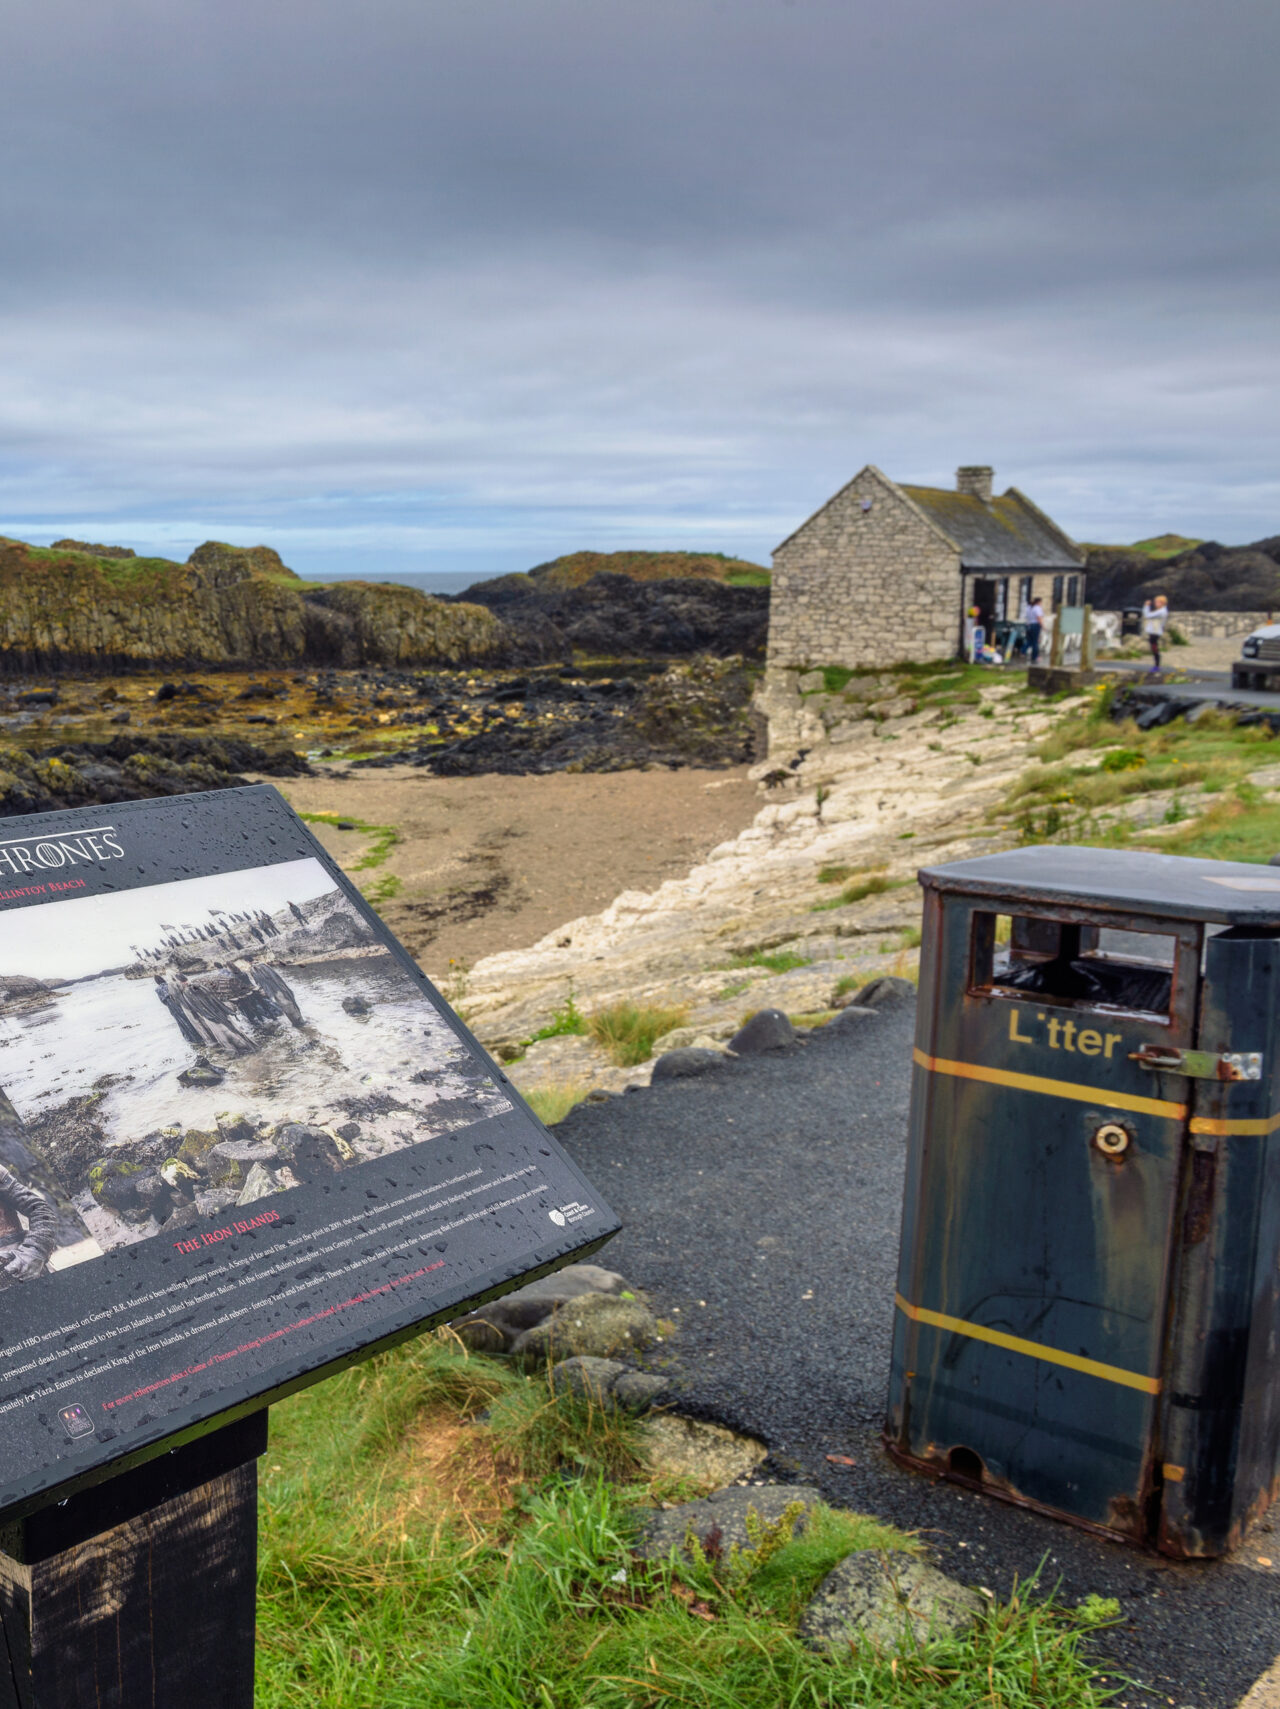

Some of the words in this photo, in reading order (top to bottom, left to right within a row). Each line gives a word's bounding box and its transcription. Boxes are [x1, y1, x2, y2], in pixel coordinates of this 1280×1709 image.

[48, 879, 86, 893] BEACH
[1008, 1009, 1123, 1058] Ltter
[22, 1334, 41, 1347] HBO
[39, 1327, 61, 1340] series
[59, 1319, 80, 1333] based
[87, 1307, 115, 1324] George
[112, 1302, 127, 1313] R.R.
[126, 1292, 154, 1307] Martin's
[151, 1279, 188, 1299] best-selling
[184, 1271, 209, 1287] fantasy
[226, 1261, 234, 1269] A
[232, 1256, 250, 1268] Song
[247, 1253, 256, 1261] of
[253, 1249, 265, 1259] Ice
[262, 1246, 275, 1255] and
[273, 1241, 288, 1251] Fire.
[286, 1235, 304, 1246] Since
[301, 1232, 312, 1240] the
[310, 1227, 326, 1238] pilot
[341, 1217, 352, 1225] the
[350, 1211, 366, 1222] show
[363, 1208, 375, 1216] has
[372, 1202, 391, 1213] filmed
[389, 1198, 405, 1207] across
[403, 1190, 422, 1201] various
[420, 1182, 442, 1195] locations
[445, 1173, 467, 1185] Northern
[173, 1239, 200, 1255] THE
[200, 1226, 234, 1246] IRON
[233, 1209, 280, 1234] ISLANDS
[1, 1359, 39, 1381] presumed
[36, 1351, 58, 1366] dead,
[55, 1346, 70, 1357] has
[68, 1335, 98, 1352] returned
[97, 1332, 107, 1341] to
[104, 1328, 118, 1338] the
[115, 1322, 131, 1334] Iron
[129, 1314, 154, 1328] Islands
[152, 1309, 166, 1319] and
[166, 1302, 185, 1314] killed
[184, 1298, 195, 1307] his
[193, 1288, 219, 1304] brother,
[216, 1282, 236, 1294] Balon.
[236, 1277, 247, 1286] At
[244, 1274, 256, 1283] the
[253, 1266, 277, 1280] funeral,
[275, 1258, 296, 1271] Balon's
[294, 1248, 322, 1265] daughter,
[319, 1243, 333, 1253] Yara
[353, 1231, 369, 1240] vows
[366, 1226, 378, 1235] she
[375, 1222, 388, 1231] will
[386, 1217, 406, 1229] avenge
[402, 1212, 413, 1221] her
[410, 1206, 430, 1217] father's
[427, 1201, 443, 1211] death
[440, 1198, 450, 1207] by
[447, 1192, 467, 1204] finding
[463, 1189, 472, 1197] the
[490, 1178, 501, 1186] and
[23, 1391, 36, 1402] for
[34, 1384, 56, 1398] Yara,
[53, 1375, 77, 1390] Euron
[75, 1372, 83, 1381] is
[82, 1361, 111, 1378] declared
[110, 1354, 130, 1368] King
[126, 1351, 136, 1360] of
[134, 1346, 147, 1357] the
[145, 1341, 160, 1352] Iron
[158, 1331, 185, 1347] Islands,
[182, 1329, 191, 1337] is
[188, 1318, 217, 1334] drowned
[215, 1313, 229, 1323] and
[227, 1305, 249, 1319] reborn
[250, 1296, 274, 1311] forcing
[270, 1291, 286, 1301] Yara
[283, 1286, 296, 1296] and
[294, 1282, 306, 1292] her
[304, 1274, 328, 1288] brother,
[343, 1264, 351, 1272] to
[349, 1259, 362, 1269] take
[366, 1253, 377, 1262] the
[374, 1249, 388, 1258] Iron
[385, 1244, 400, 1254] Fleet
[397, 1240, 409, 1249] and
[407, 1236, 418, 1245] flee
[418, 1227, 443, 1242] knowing
[439, 1223, 451, 1231] that
[448, 1217, 465, 1228] Euron
[462, 1213, 474, 1222] will
[101, 1399, 115, 1411] For
[115, 1394, 133, 1405] more
[131, 1376, 170, 1398] information
[168, 1368, 188, 1382] about
[186, 1360, 207, 1374] Game
[204, 1357, 215, 1366] of
[212, 1347, 238, 1363] Thrones
[236, 1338, 261, 1354] filming
[257, 1327, 285, 1344] locations
[282, 1325, 291, 1333] in
